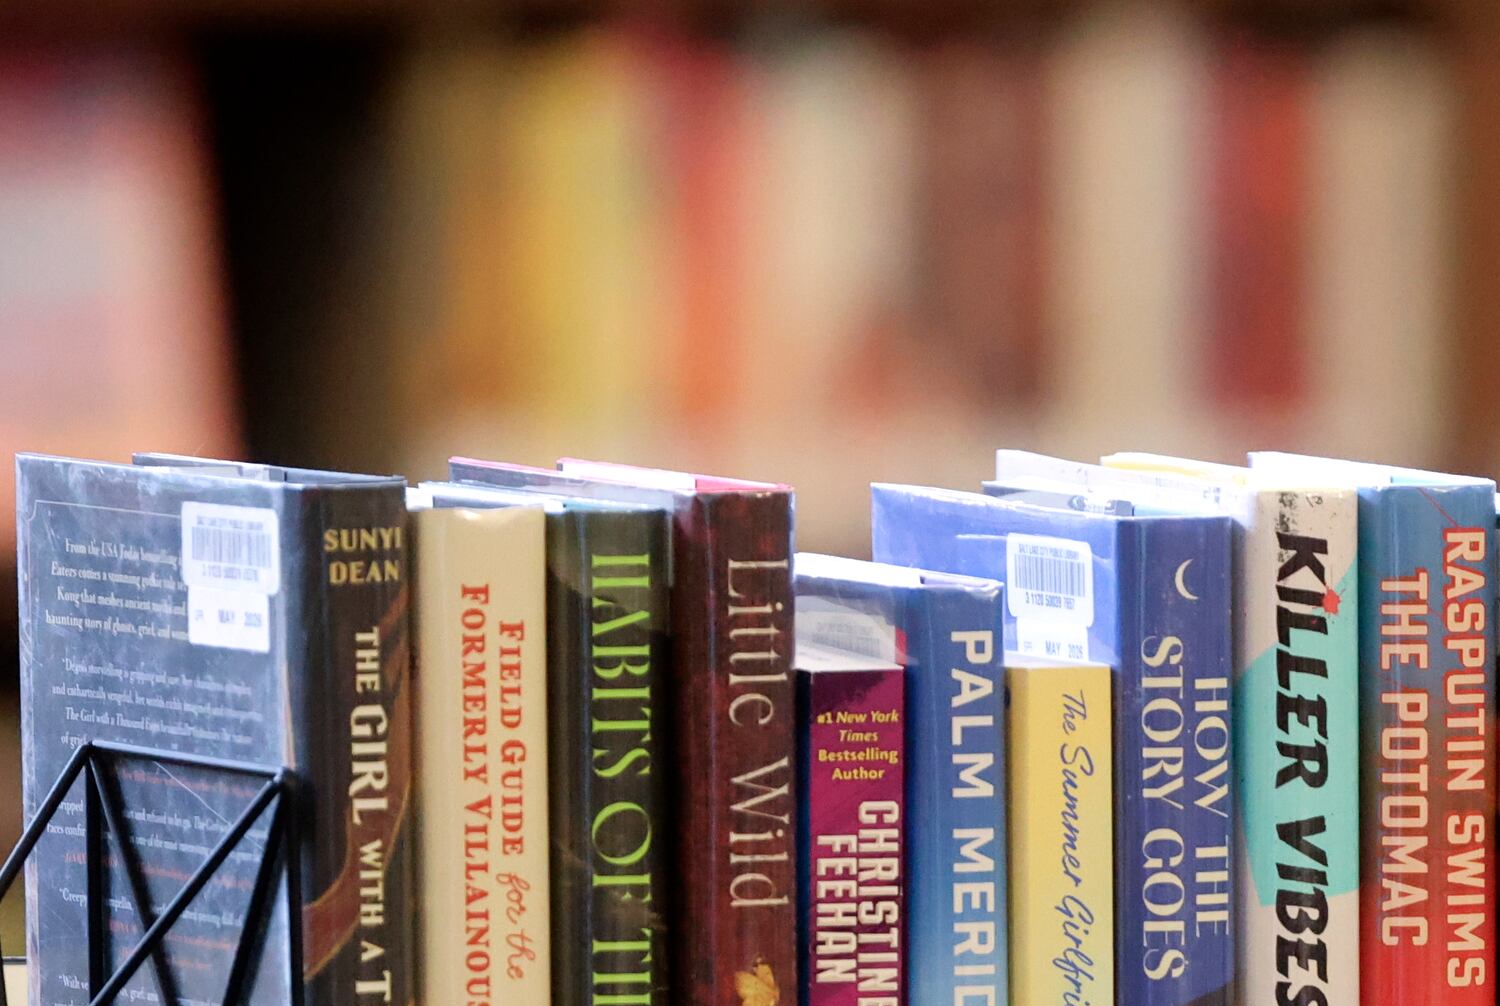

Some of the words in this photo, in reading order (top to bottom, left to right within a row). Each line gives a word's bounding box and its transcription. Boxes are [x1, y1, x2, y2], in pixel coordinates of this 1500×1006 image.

[330, 561, 399, 583] DEAN
[1381, 569, 1428, 671] THE
[354, 627, 379, 692] THE
[461, 584, 489, 781] FORMERLY
[500, 620, 524, 728] FIELD
[591, 553, 651, 779] HABITS
[727, 558, 789, 727] Little
[1275, 531, 1329, 789] KILLER
[1445, 528, 1485, 791] RASPUTIN
[351, 703, 388, 824] GIRL
[818, 749, 898, 764] Bestselling
[836, 711, 867, 723] New
[870, 710, 899, 722] York
[839, 730, 878, 741] Times
[951, 630, 994, 798] PALM
[1061, 690, 1087, 736] The
[1141, 635, 1184, 810] STORY
[1194, 678, 1229, 818] HOW
[501, 739, 527, 856] GUIDE
[832, 767, 885, 780] Author
[1054, 747, 1095, 887] Summer
[1381, 693, 1429, 947] POTOMAC
[360, 840, 384, 925] WITH
[592, 801, 652, 909] OF
[730, 758, 789, 908] Wild
[1195, 835, 1230, 938] THE
[361, 943, 384, 962] A
[499, 871, 522, 926] for
[507, 931, 535, 981] the
[816, 834, 858, 983] FEEHAN
[1141, 828, 1186, 982] GOES
[1446, 813, 1486, 988] SWIMS
